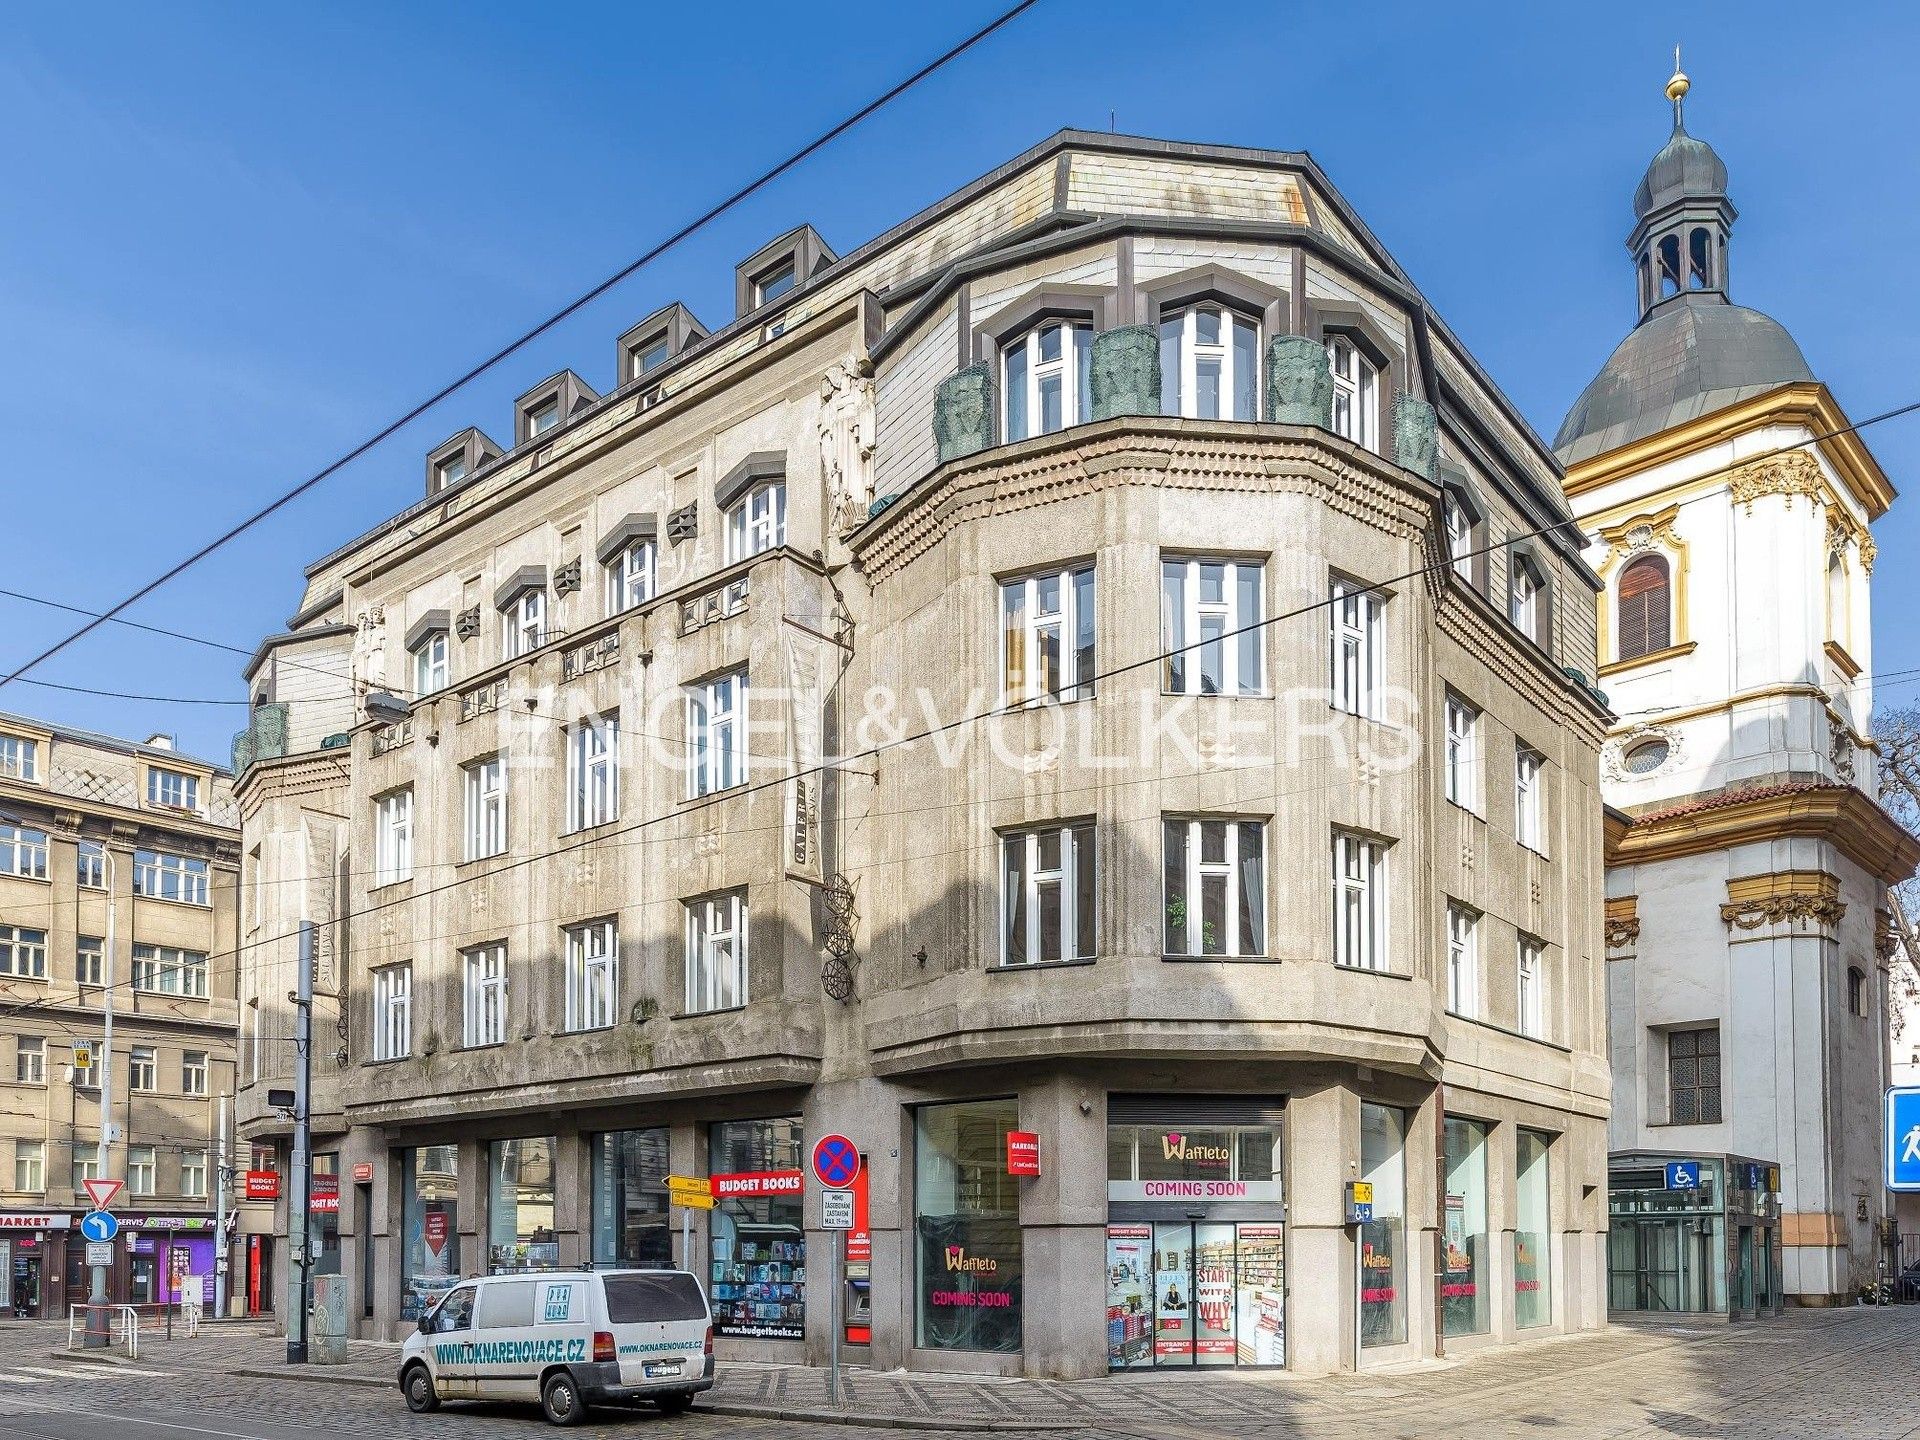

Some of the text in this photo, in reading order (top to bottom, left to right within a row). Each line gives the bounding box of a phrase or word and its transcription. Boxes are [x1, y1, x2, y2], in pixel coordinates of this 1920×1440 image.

[795, 779, 807, 864] GALERIE
[76, 1053, 89, 1062] 40
[1162, 1133, 1229, 1160] Waffleto
[719, 1179, 760, 1192] BUDGET
[762, 1177, 800, 1191] BOOKS
[1145, 1182, 1246, 1196] COMING SOON
[311, 1199, 328, 1209] DGET
[117, 1218, 144, 1226] SERVIS
[945, 1245, 997, 1271] Waffleto
[1199, 1269, 1232, 1283] START
[932, 1291, 1010, 1307] COMING SOON
[1199, 1288, 1232, 1296] WITH
[1199, 1301, 1231, 1320] WHY
[721, 1326, 803, 1338] www.budgetbooks.cz
[434, 1338, 587, 1366] WWW.OKNARENOVACE.CZ
[618, 1340, 703, 1355] WWW.OKNARENOVACE.CZ
